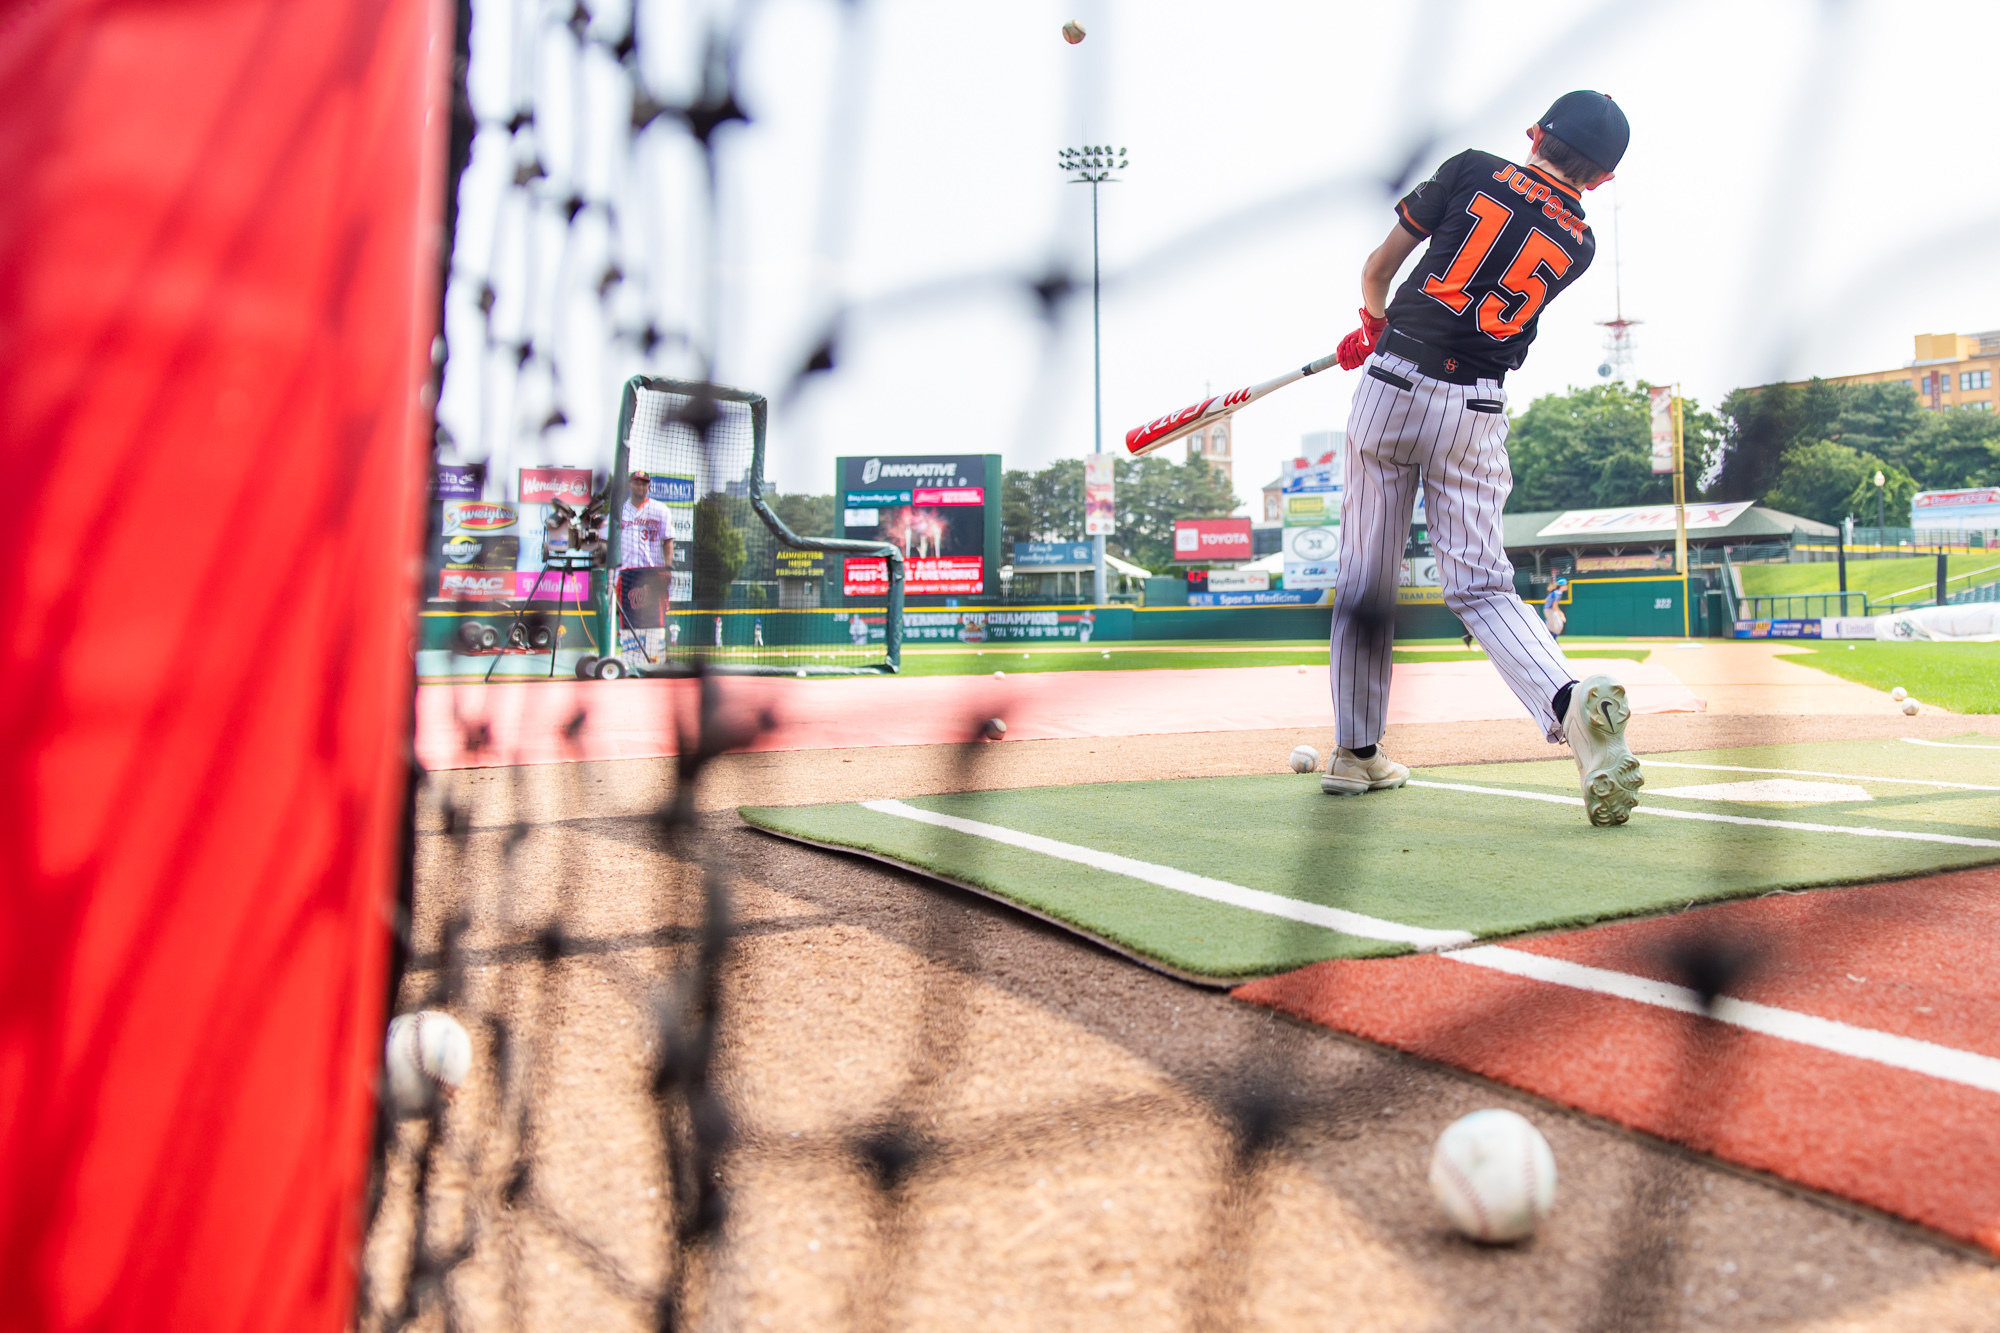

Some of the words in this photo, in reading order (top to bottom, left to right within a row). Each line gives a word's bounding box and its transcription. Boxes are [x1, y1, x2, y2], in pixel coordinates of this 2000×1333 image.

[1417, 190, 1574, 342] 15
[881, 463, 957, 477] INNOVATIVE
[523, 476, 569, 496] Wendy's
[648, 480, 694, 496] SUMMIT
[915, 477, 968, 488] FIELD
[1552, 507, 1735, 530] RE/MAX
[640, 528, 659, 542] 37
[1200, 533, 1249, 545] TOYOTA
[776, 551, 824, 559] ADVERTISE
[914, 568, 979, 581] FIREWORKS
[442, 575, 504, 589] ISAAC
[1211, 577, 1246, 587] KeyBank
[1219, 593, 1253, 606] Sports
[1254, 593, 1301, 604] Medicine
[1400, 592, 1424, 600] TEAM
[1654, 598, 1672, 609] 322
[962, 612, 985, 625] CUP
[987, 612, 1060, 625] CHAMPIONS
